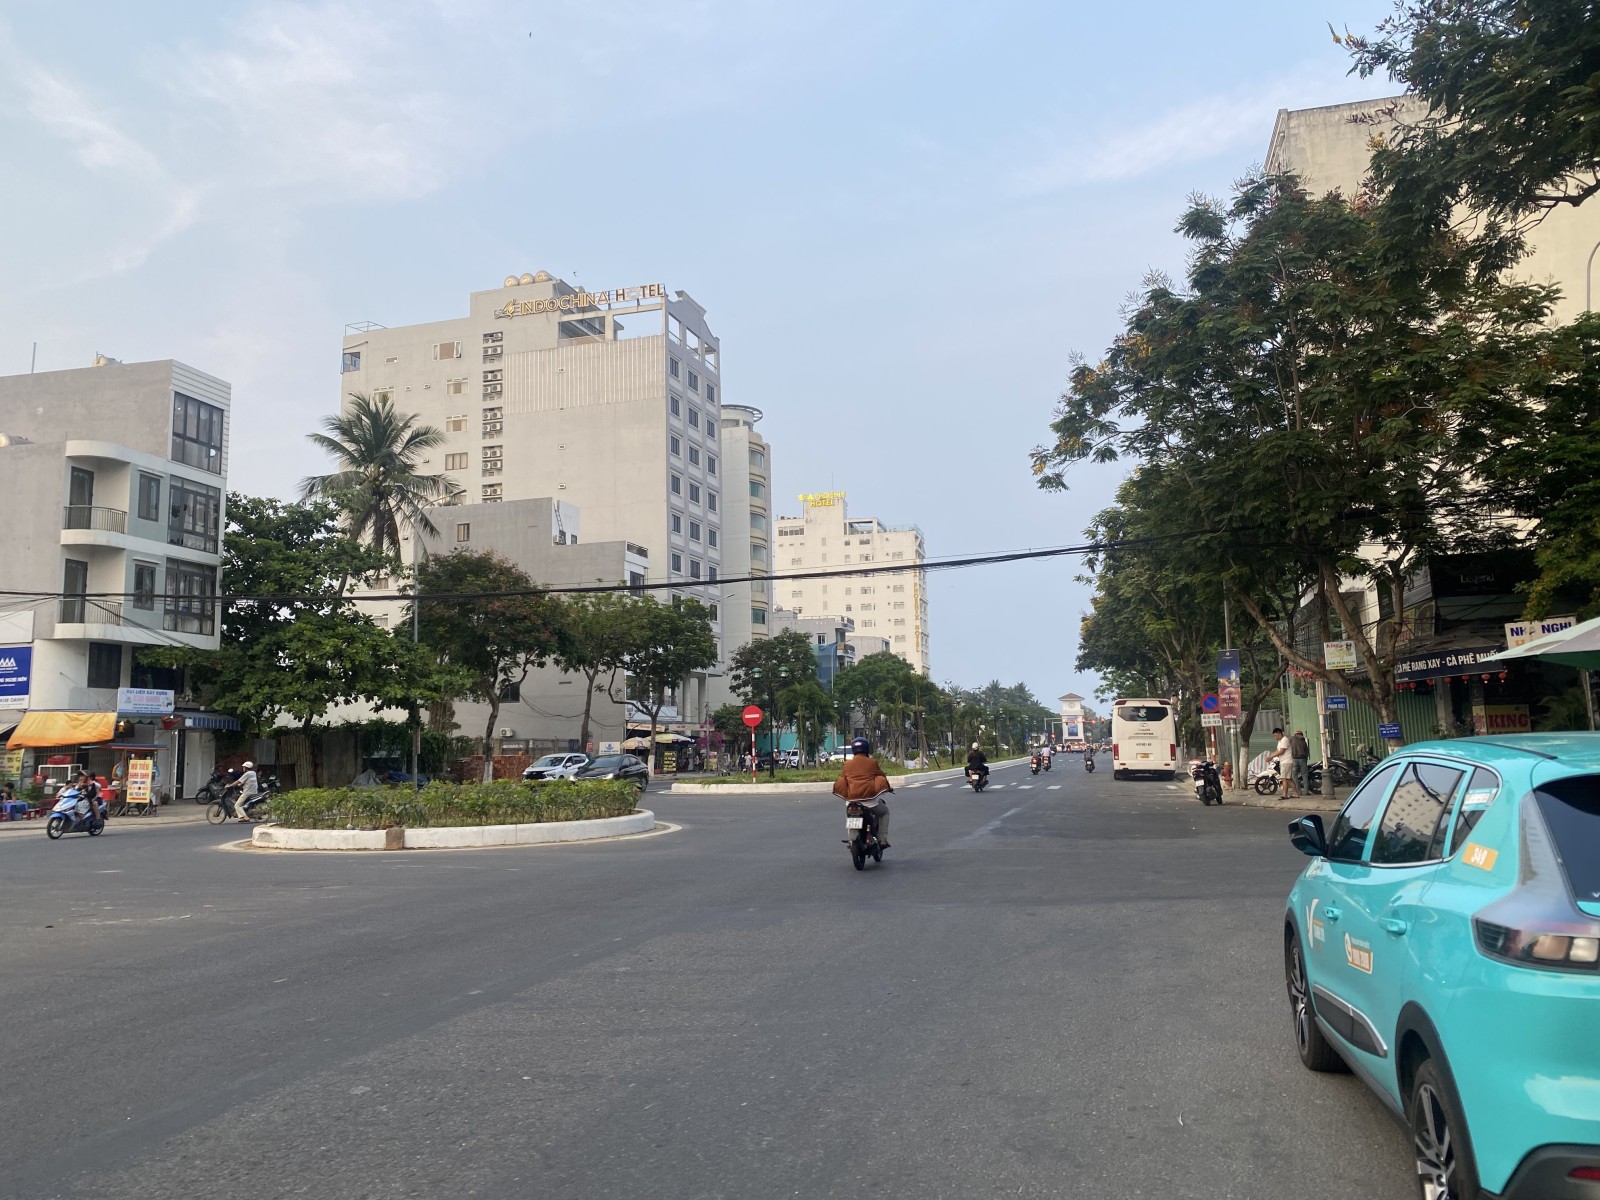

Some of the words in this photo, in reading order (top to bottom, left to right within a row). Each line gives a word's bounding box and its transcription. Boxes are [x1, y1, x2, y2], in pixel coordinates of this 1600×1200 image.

[519, 290, 610, 315] INDOCHINA
[615, 283, 665, 302] HOTEL
[810, 499, 835, 507] HOTEL
[1411, 659, 1427, 671] RANG
[1427, 658, 1441, 669] XAY
[1446, 654, 1458, 667] CÀ
[1458, 652, 1475, 665] PHÊ
[1488, 713, 1529, 728] KING
